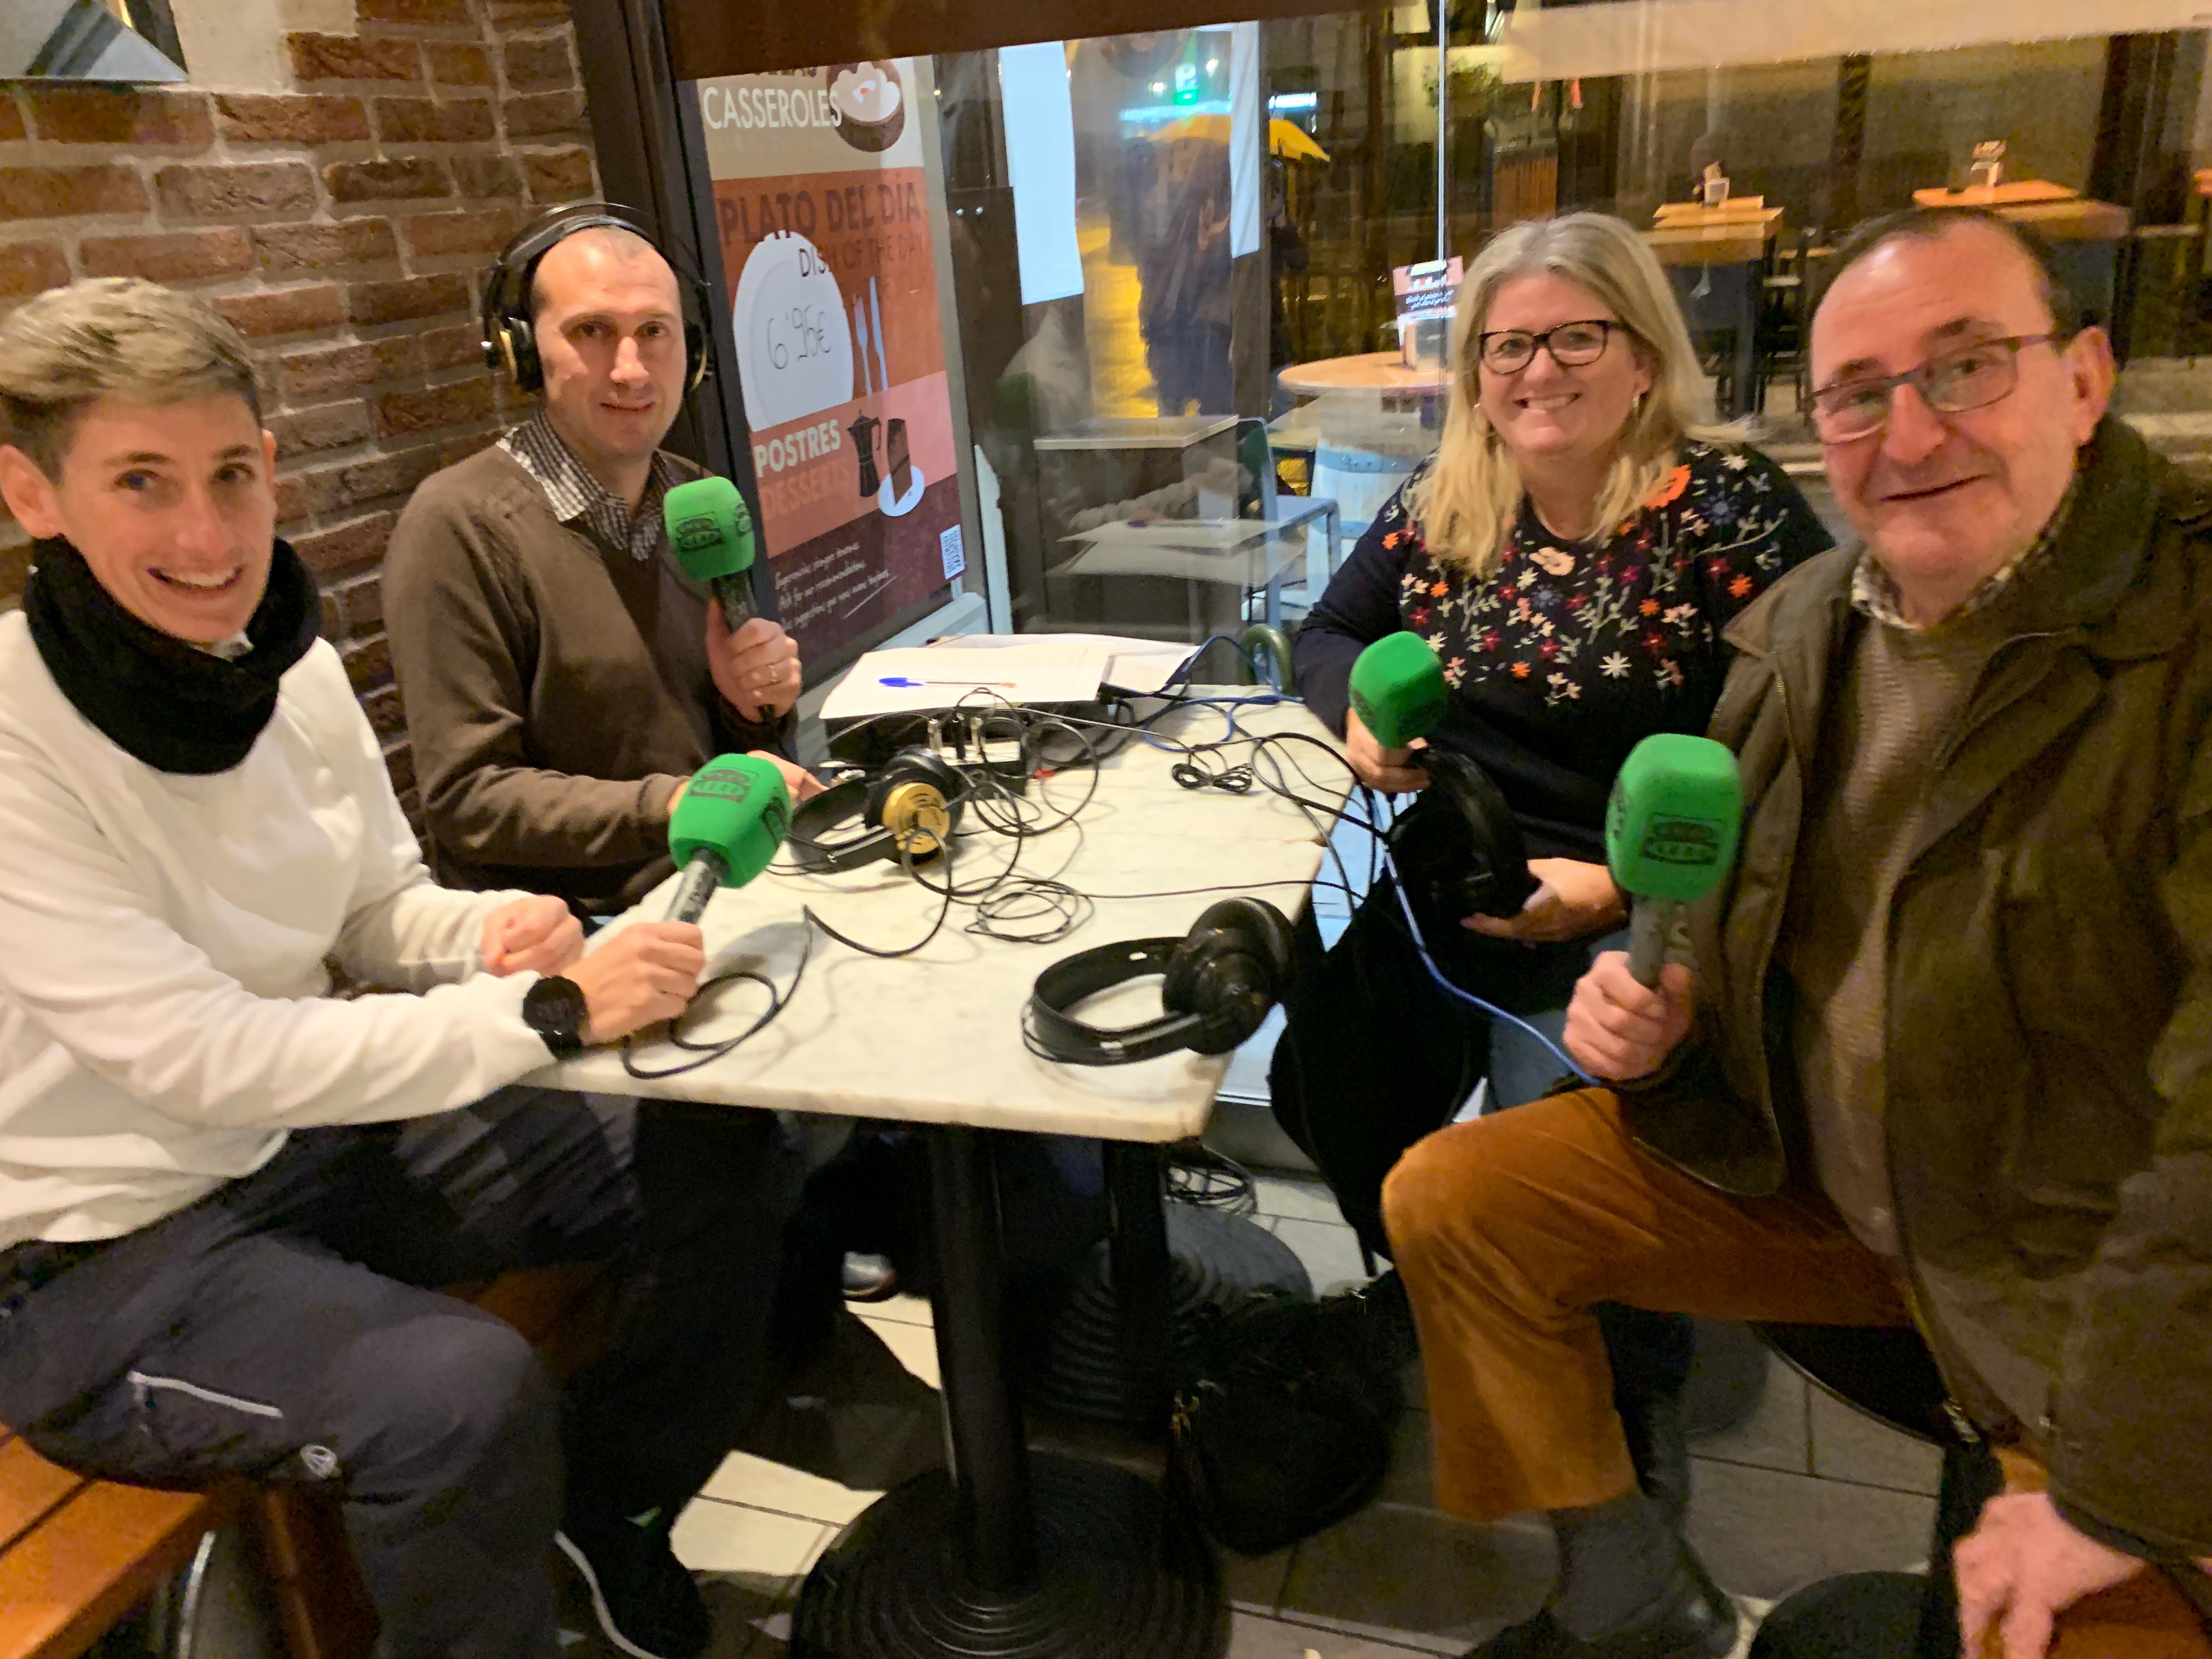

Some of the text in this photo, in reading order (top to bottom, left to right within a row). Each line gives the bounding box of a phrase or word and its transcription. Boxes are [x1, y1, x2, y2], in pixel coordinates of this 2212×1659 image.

[703, 87, 843, 129] CASSEROLES
[719, 190, 817, 246] PLATO
[825, 184, 874, 234] DEL
[754, 419, 842, 478] POSTRES
